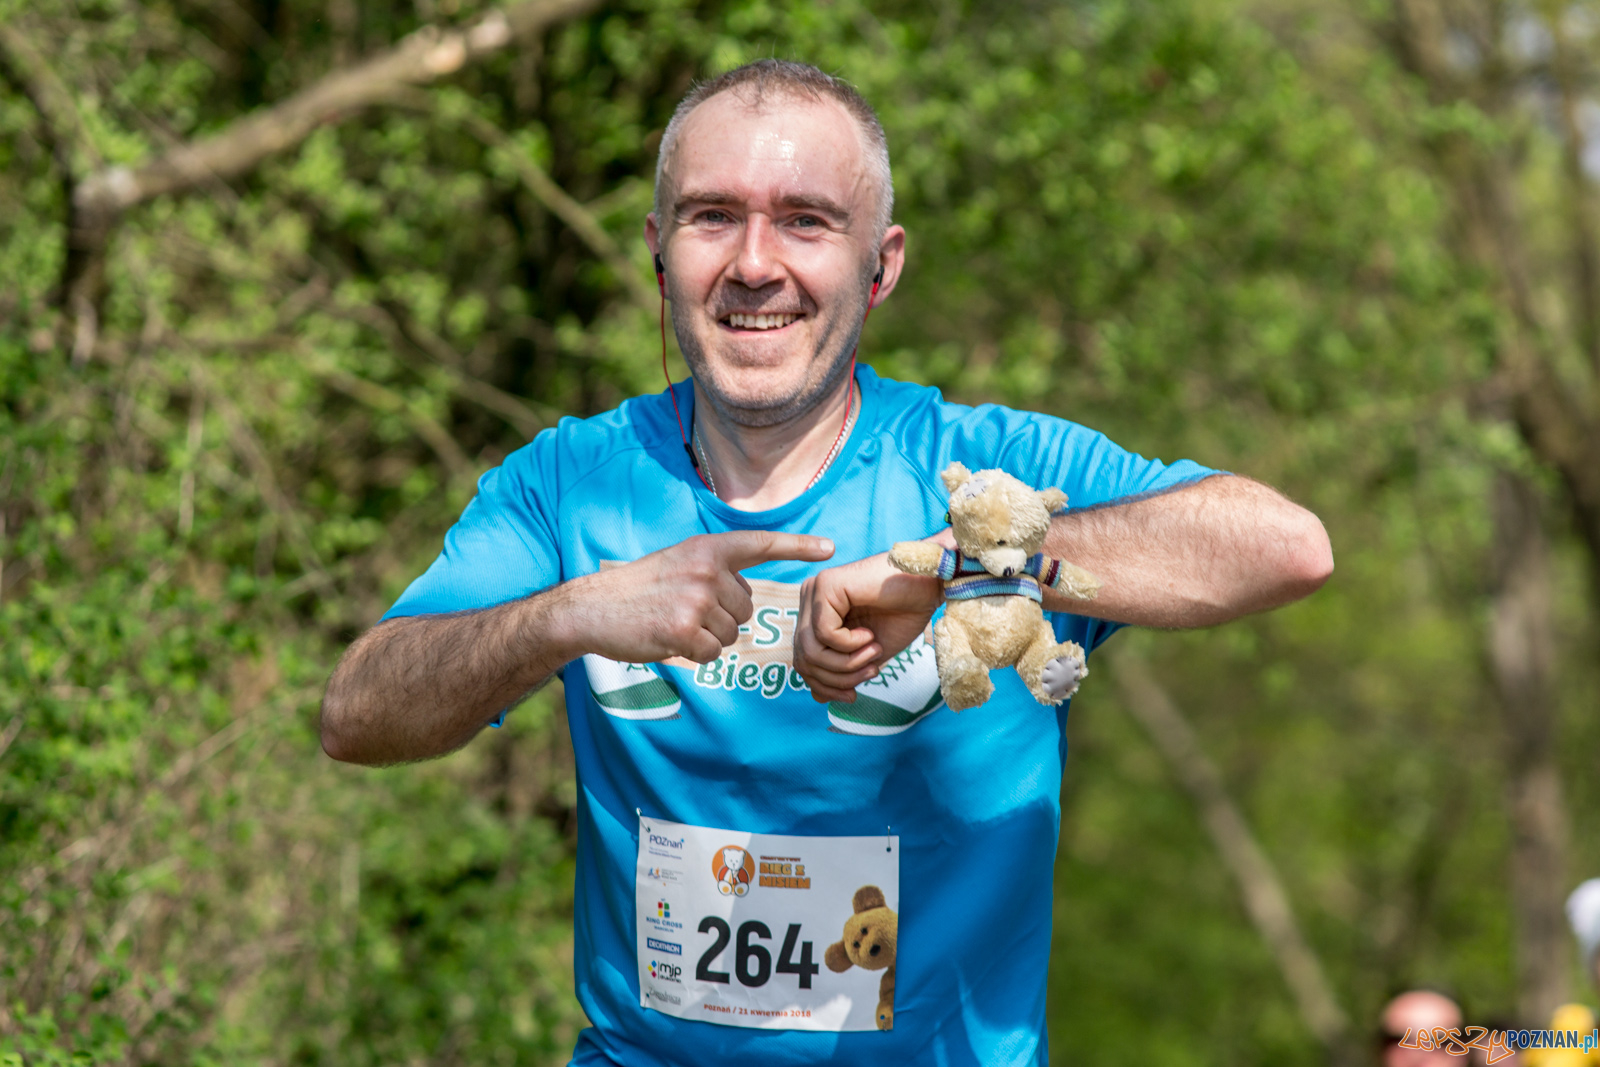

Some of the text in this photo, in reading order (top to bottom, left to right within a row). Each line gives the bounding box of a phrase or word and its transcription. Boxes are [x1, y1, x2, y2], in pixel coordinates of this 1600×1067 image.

[759, 862, 792, 875] BIEG
[759, 875, 811, 889] MISIEM
[646, 916, 683, 929] KING CROSS
[696, 916, 819, 989] 264
[660, 963, 682, 978] mjp
[739, 1007, 749, 1015] 21
[790, 1010, 811, 1018] 2018
